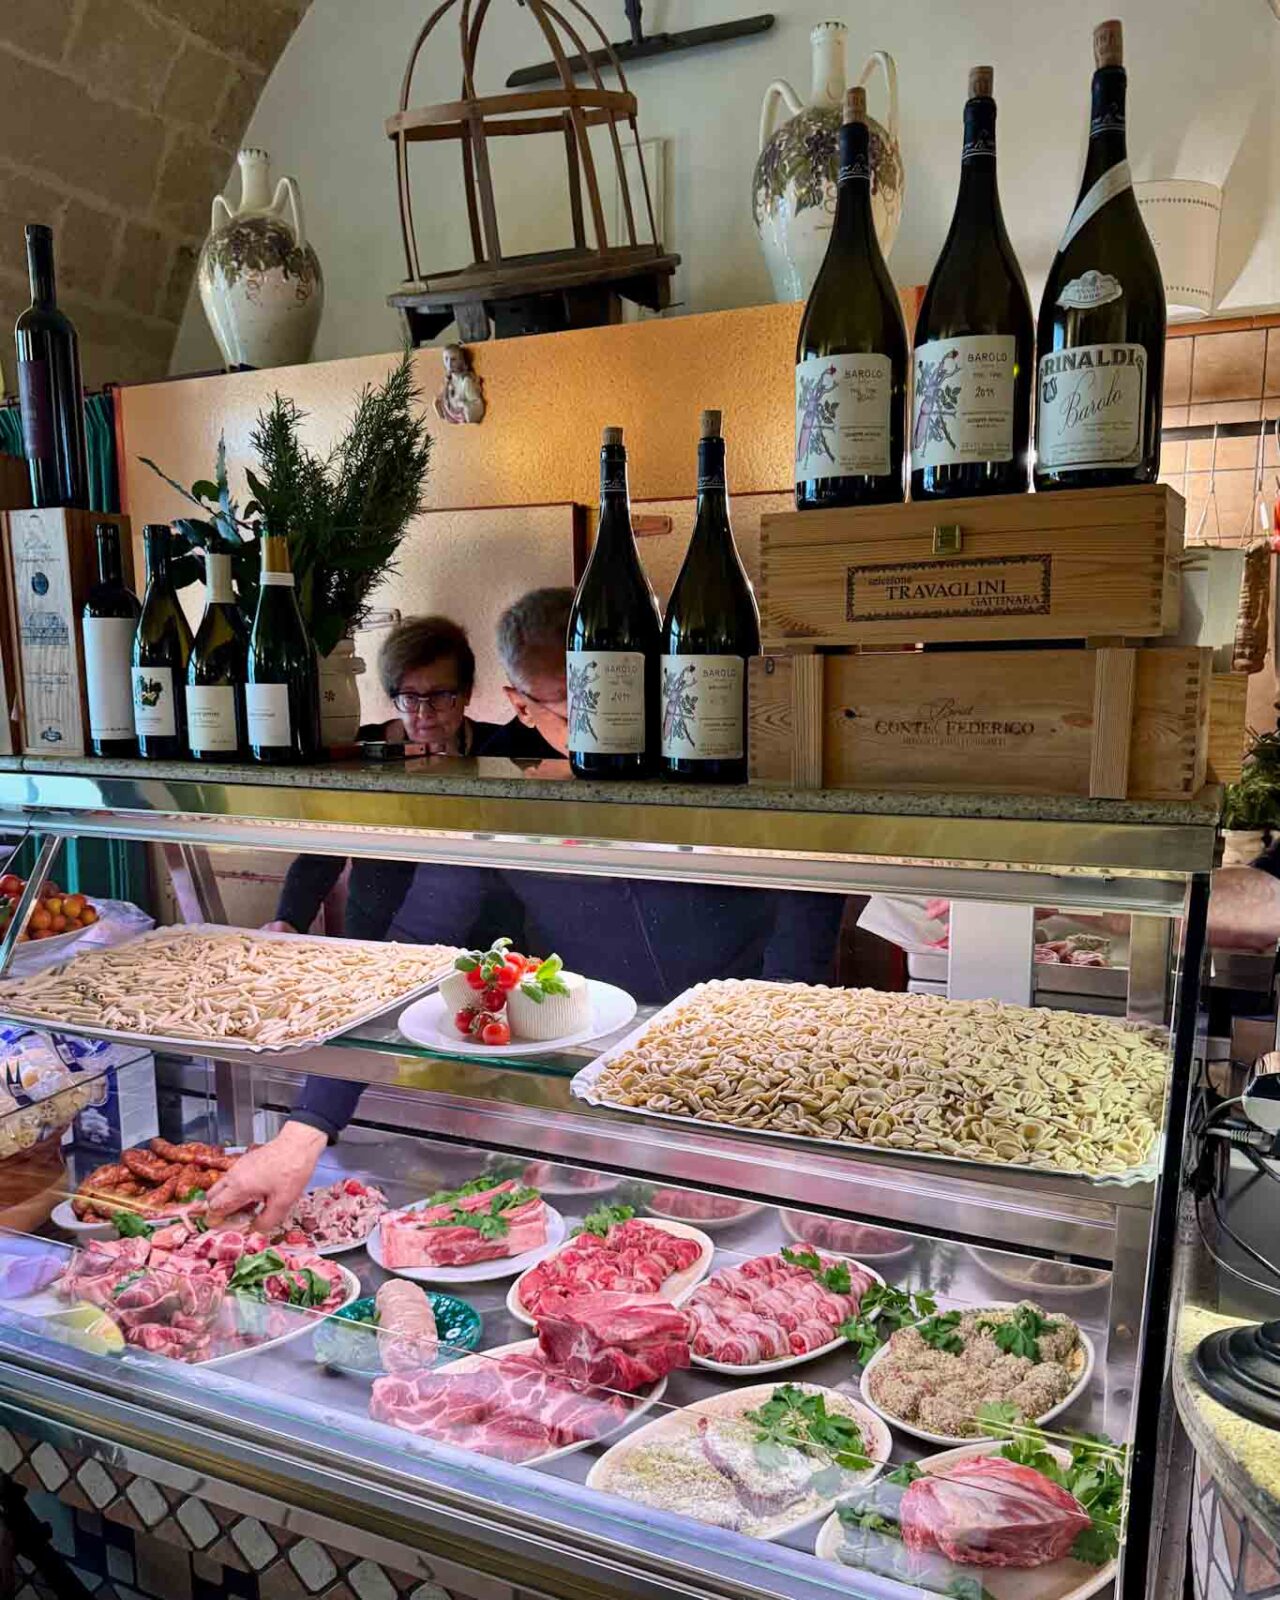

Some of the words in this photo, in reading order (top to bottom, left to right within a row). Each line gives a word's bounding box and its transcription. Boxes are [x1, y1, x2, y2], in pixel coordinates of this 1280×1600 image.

[967, 352, 1008, 362] BAROLO
[1044, 348, 1136, 376] RINALDI
[844, 368, 882, 379] BAROLO
[1058, 369, 1123, 436] Barolo
[885, 579, 1007, 600] TRAVAGLINI
[971, 595, 1041, 607] GATTINARA
[703, 669, 737, 678] BAROLO
[946, 720, 1035, 736] FEDERICO
